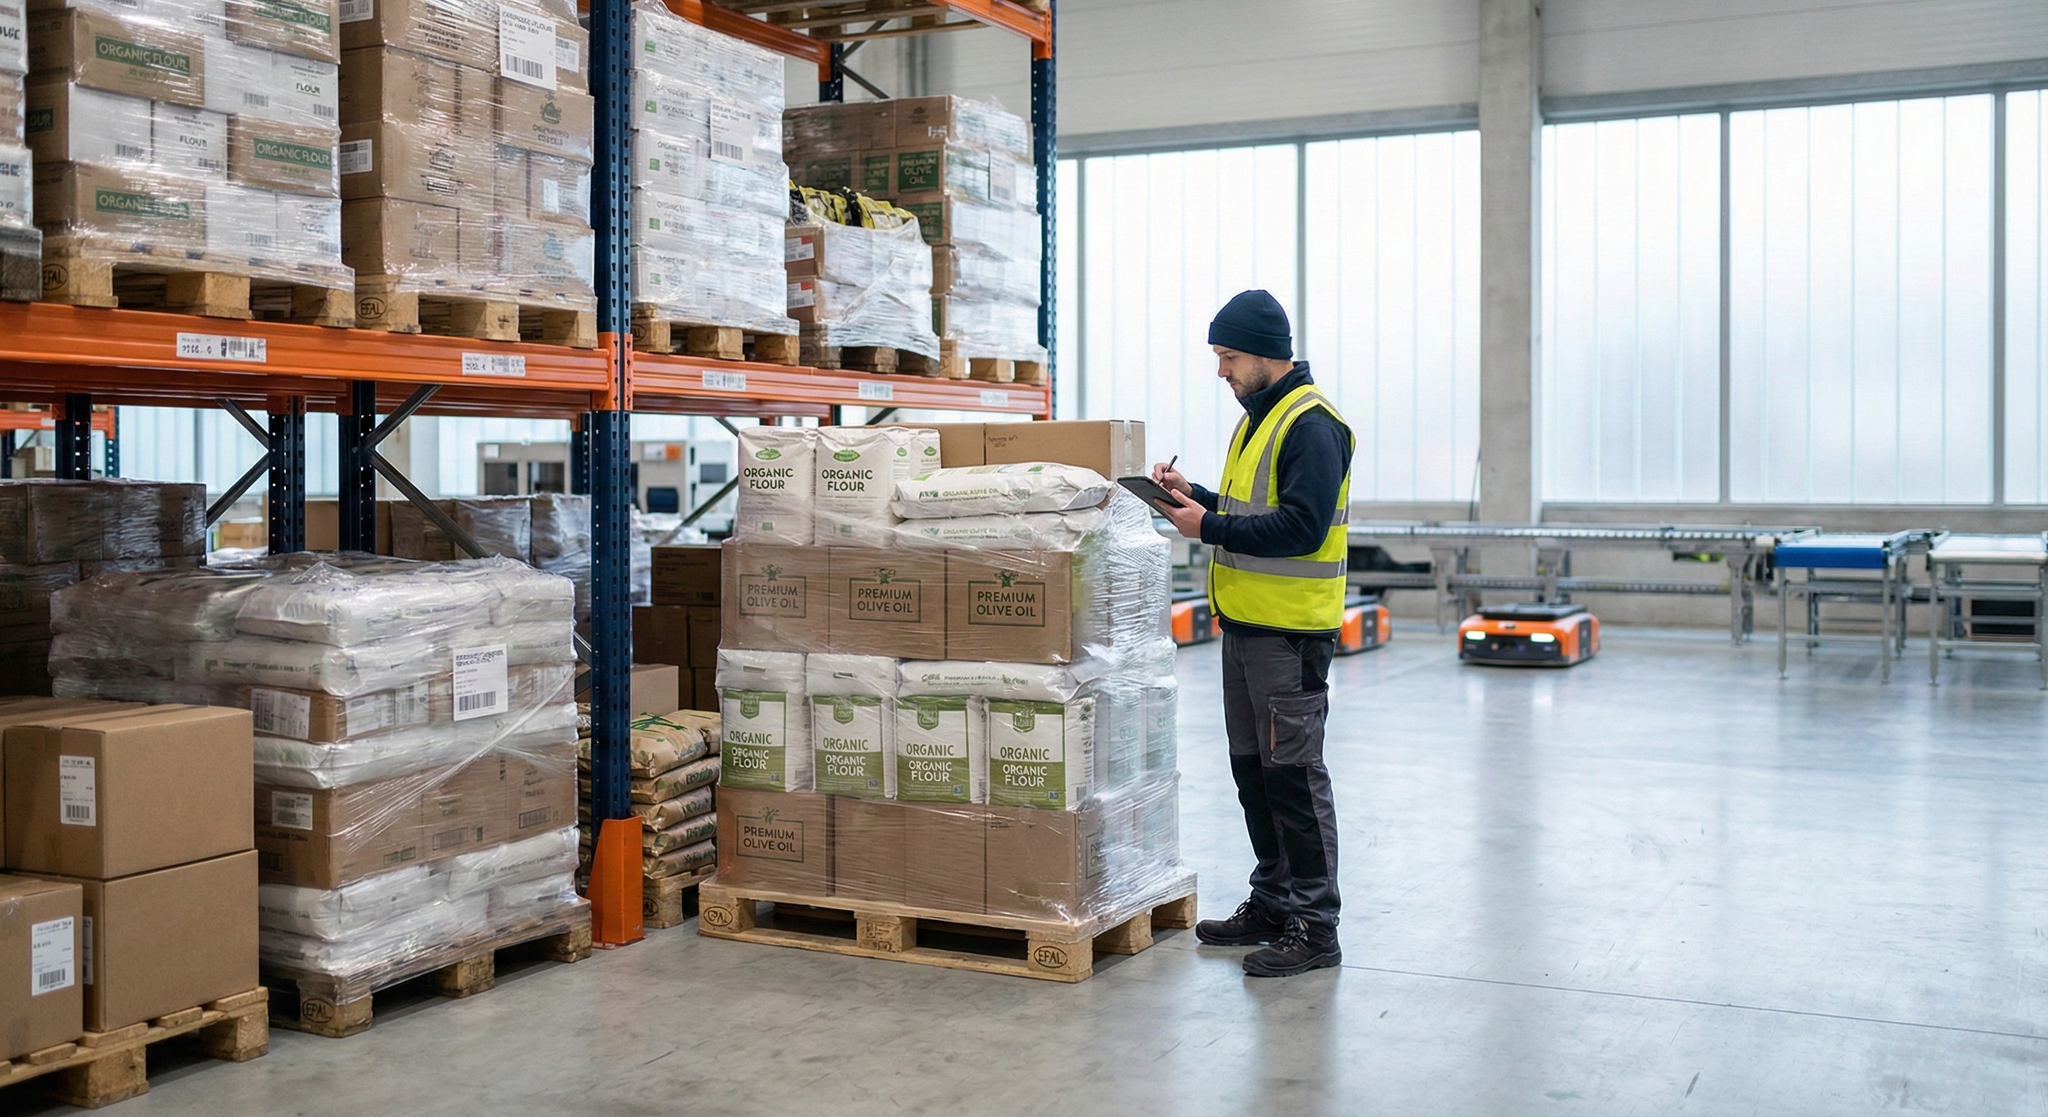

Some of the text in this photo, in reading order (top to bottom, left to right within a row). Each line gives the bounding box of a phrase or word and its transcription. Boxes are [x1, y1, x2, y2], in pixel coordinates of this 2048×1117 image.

[99, 42, 188, 70] ORGANIC FLOUR
[29, 112, 51, 127] OUR
[257, 143, 301, 161] ORGANIC
[744, 467, 794, 478] ORGANIC
[821, 469, 873, 480] ORGANIC
[749, 480, 785, 490] FLOUR
[827, 481, 865, 492] FLOUR
[747, 584, 798, 596] PREMIUM
[858, 588, 912, 600] PREMIUM
[747, 597, 799, 609] OLIVE OIL
[978, 591, 1036, 603] PREMIUM
[857, 601, 913, 613] OLIVE OIL
[976, 605, 1036, 617] OLIVE OIL
[729, 730, 772, 745] ORGANIC
[823, 737, 869, 751] ORGANIC
[906, 743, 954, 756] ORGANIC
[731, 747, 769, 760] ORGANIC
[1000, 747, 1050, 760] ORGANIC
[733, 757, 767, 770] FLOUR
[825, 754, 866, 767] ORGANIC
[909, 760, 952, 772] ORGANIC
[1002, 764, 1048, 776] ORGANIC
[911, 771, 950, 782] FLOUR
[1004, 775, 1045, 787] FLOUR
[744, 826, 795, 840] PREMIUM
[743, 838, 796, 853] OLIVE OIL
